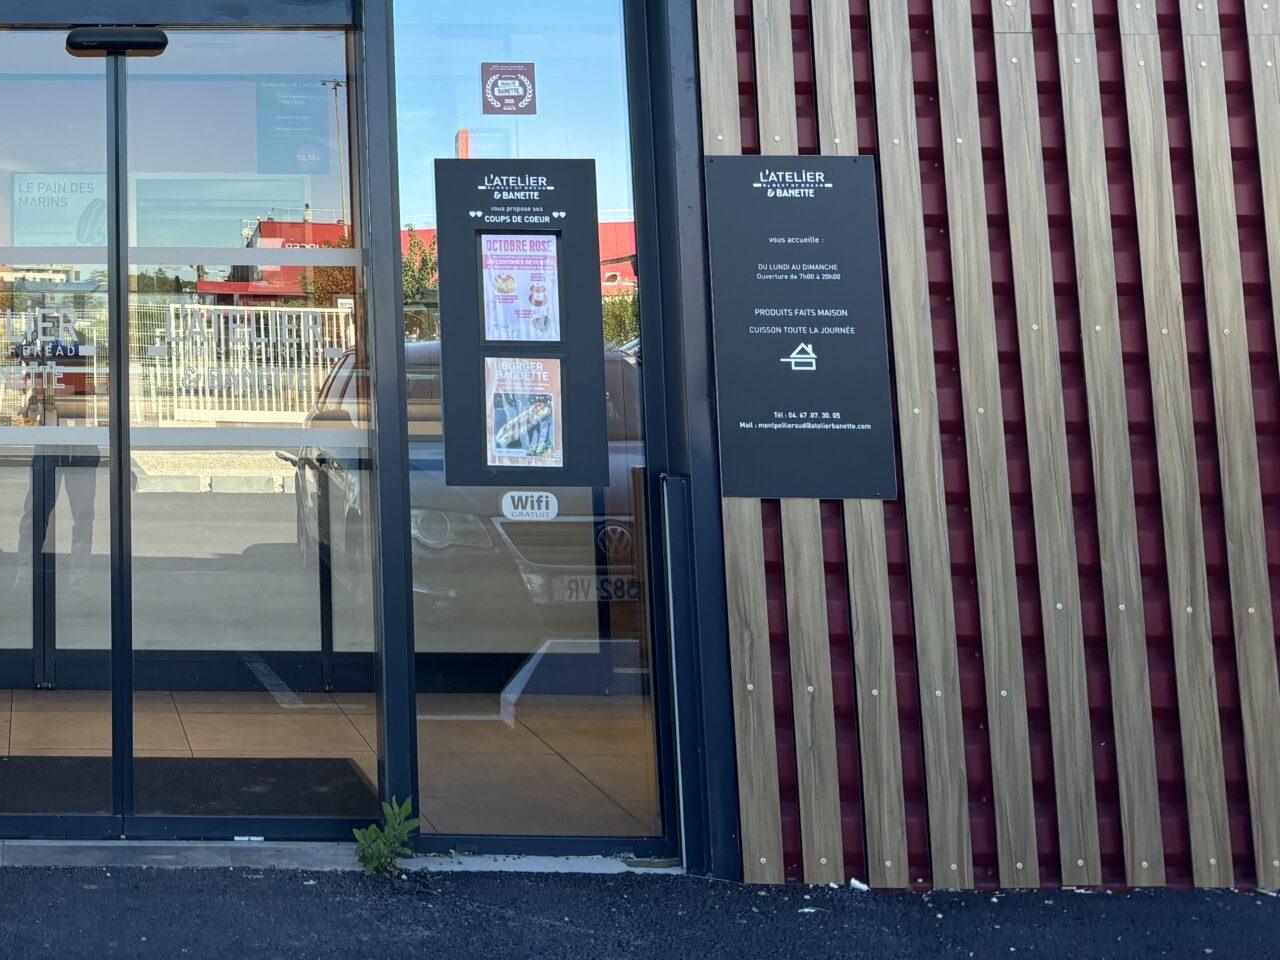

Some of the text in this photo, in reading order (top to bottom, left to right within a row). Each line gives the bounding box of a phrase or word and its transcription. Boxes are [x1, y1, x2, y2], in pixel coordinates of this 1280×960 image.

[18, 182, 95, 194] LE PAIN DES
[502, 191, 540, 200] BANETTE
[767, 189, 815, 198] & BANETTE
[18, 196, 68, 209] MARINS
[484, 215, 551, 223] COUPS DE COEUR
[486, 239, 553, 253] OCTOBRE ROSE
[757, 263, 838, 271] DU LUNDI AU DIMANCHE
[754, 308, 848, 317] PRODUITS FAITS MAISON
[749, 325, 855, 334] CUISSON TOUTE LA JOURNÉE
[22, 345, 75, 356] BREAD
[500, 361, 544, 372] BURGER
[495, 371, 550, 381] BAGUETTE
[510, 495, 550, 510] Wifi
